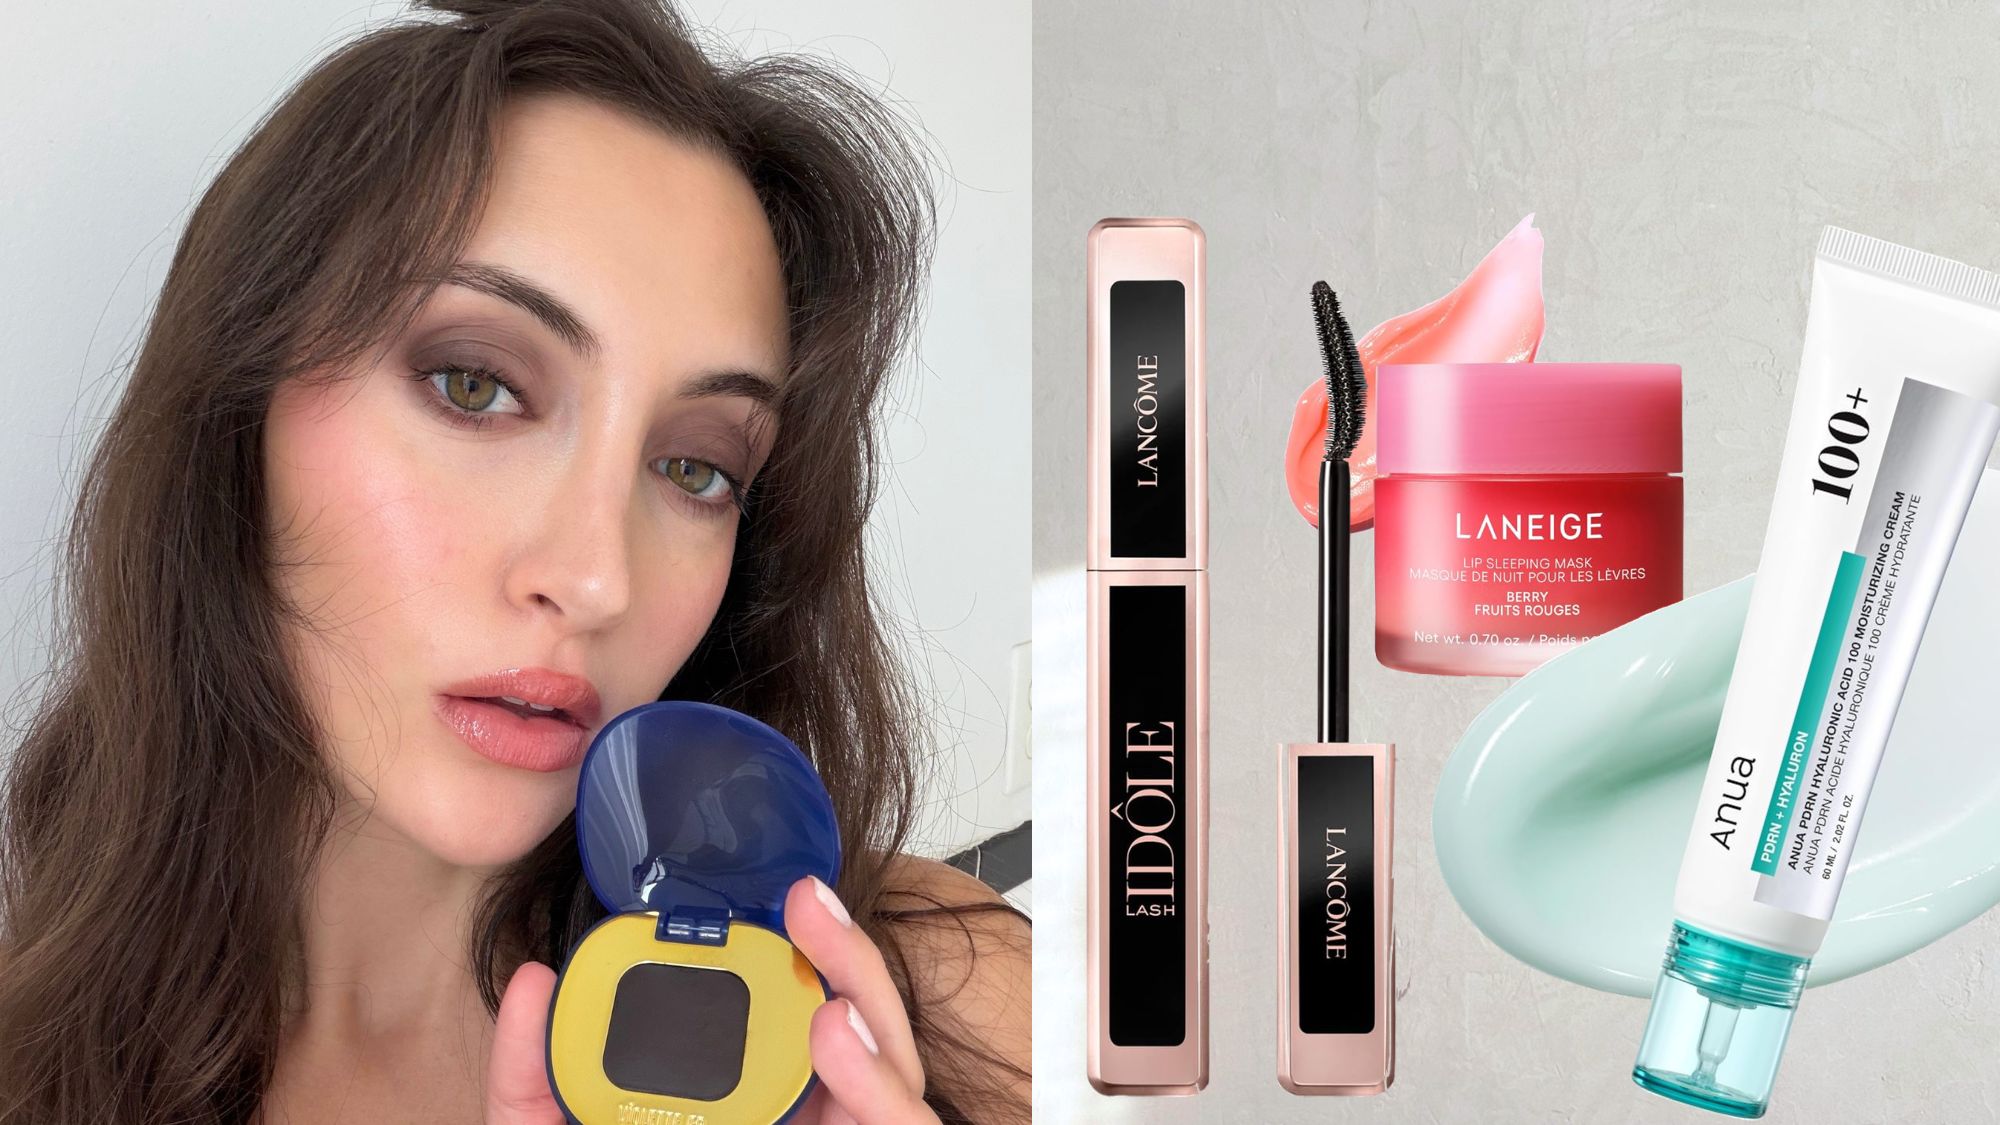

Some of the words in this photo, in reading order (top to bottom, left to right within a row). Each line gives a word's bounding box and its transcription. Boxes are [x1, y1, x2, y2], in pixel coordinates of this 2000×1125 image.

[1133, 355, 1158, 487] LANCÔME
[1812, 388, 1870, 505] 100+
[1456, 512, 1603, 540] LANEIGE
[1409, 567, 1467, 582] MASQUE
[1472, 571, 1488, 582] DE
[1493, 571, 1524, 583] NUIT
[1528, 571, 1565, 583] POUR
[1570, 571, 1593, 582] LES
[1597, 567, 1646, 582] LÈVRES
[1463, 558, 1483, 569] LIP
[1486, 558, 1550, 570] SLEEPING
[1555, 557, 1592, 569] MASK
[1506, 591, 1548, 602] BERRY
[1474, 604, 1520, 616] FRUITS
[1524, 604, 1580, 616] ROUGES
[1414, 631, 1438, 644] Net
[1443, 634, 1464, 645] wt.
[1470, 633, 1499, 647] 0.70
[1540, 634, 1577, 647] Poids
[1788, 833, 1806, 870] ANUA
[1799, 792, 1818, 830] PDRN
[1811, 702, 1843, 789] HYALURONIC
[1837, 667, 1854, 700] ACID
[1848, 642, 1861, 663] 100
[1855, 543, 1890, 639] MOISTURIZING
[1883, 491, 1905, 539] CREAM
[1803, 837, 1821, 875] ANUA
[1814, 799, 1832, 835] PDRN
[1826, 757, 1845, 797] ACIDE
[1838, 653, 1875, 755] HYALURONIQUE
[1868, 629, 1882, 650] 100
[1875, 580, 1896, 626] CRÈME
[1889, 494, 1921, 580] HYDRATANTE
[1710, 756, 1755, 850] Anua
[1761, 822, 1783, 863] PDRN
[1777, 731, 1809, 808] HYALURON
[1110, 721, 1175, 902] IDÔLE
[1833, 824, 1845, 844] 2.02
[1825, 854, 1837, 867] ML
[1822, 868, 1832, 880] 60
[1326, 827, 1351, 960] LANCÔME
[1126, 904, 1175, 916] LASH
